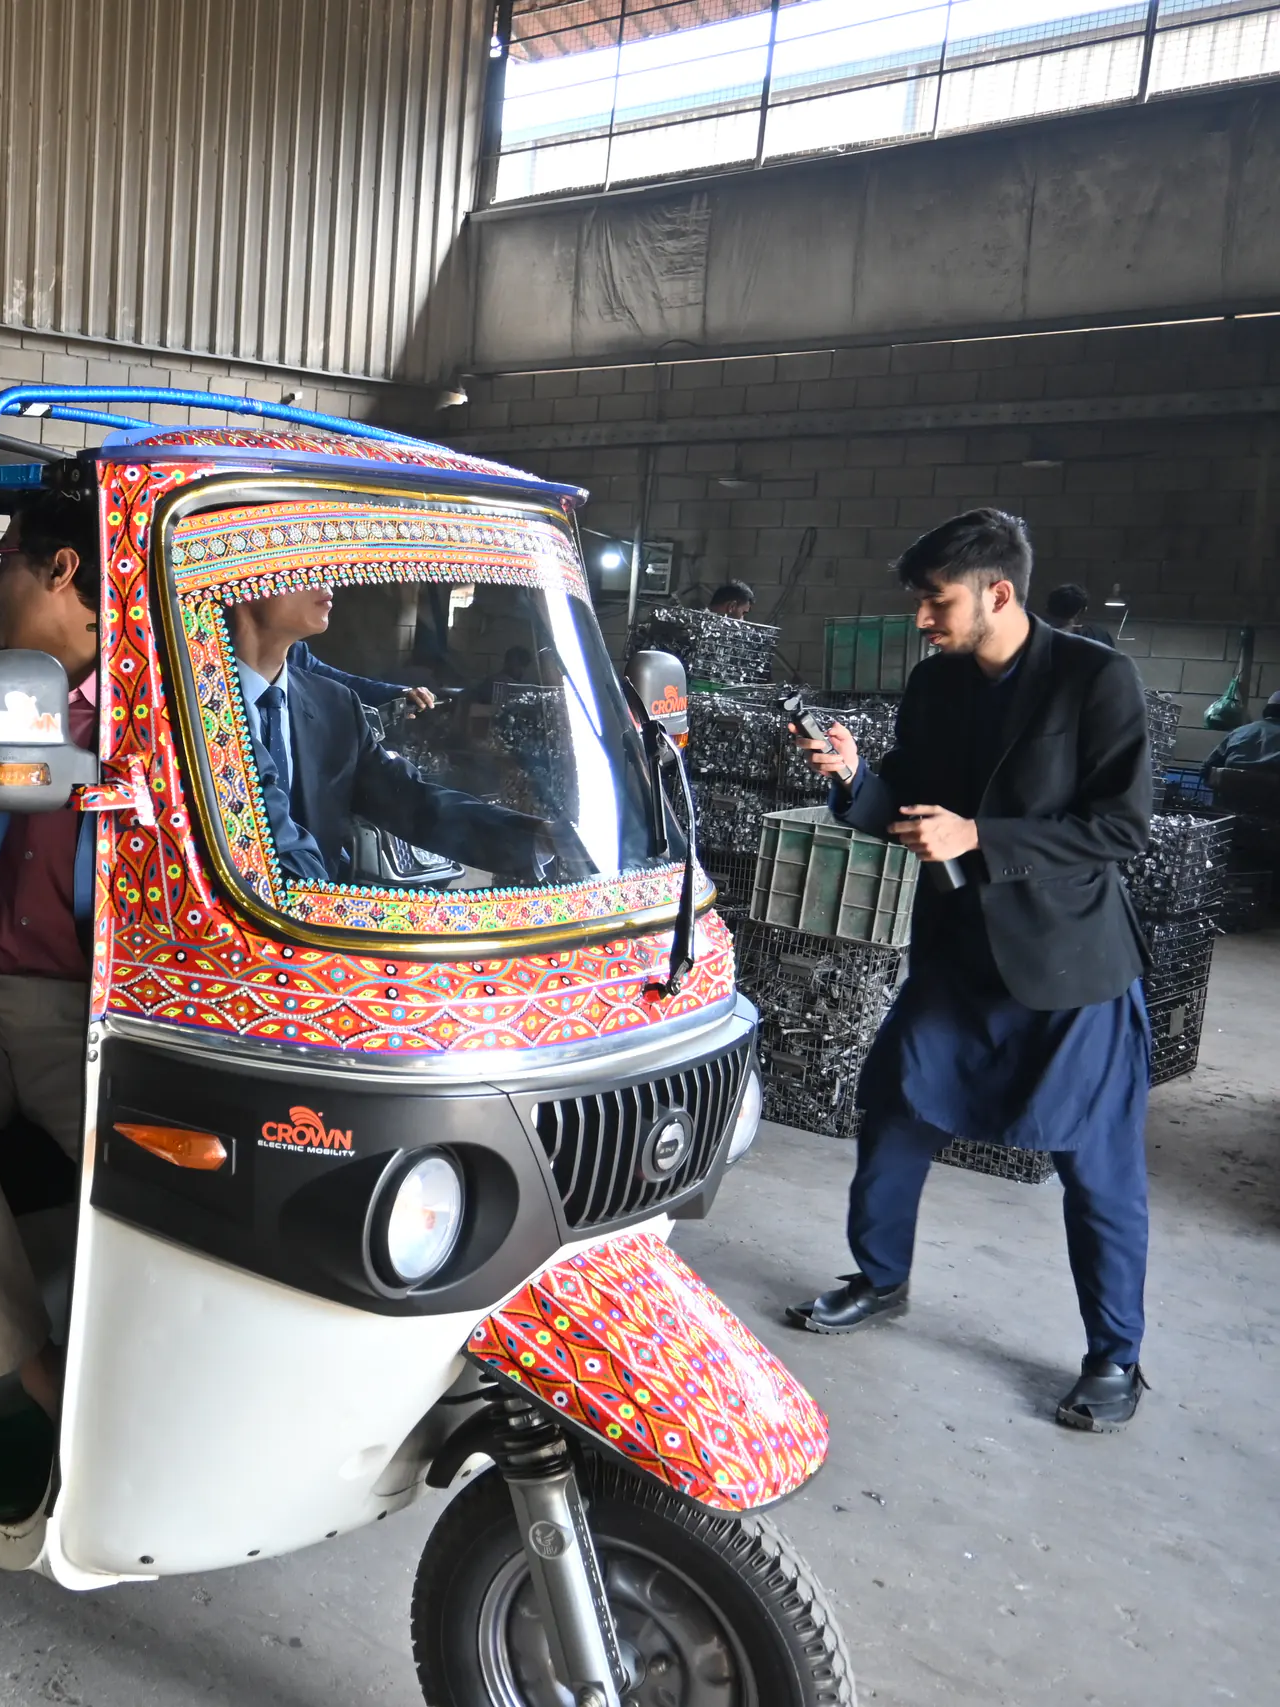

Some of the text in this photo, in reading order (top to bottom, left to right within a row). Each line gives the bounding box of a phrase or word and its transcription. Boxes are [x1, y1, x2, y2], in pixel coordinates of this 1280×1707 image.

[651, 696, 688, 715] CROWN
[261, 1120, 353, 1150] CROWN
[257, 1140, 356, 1157] ELECTRIC MOBILITY
